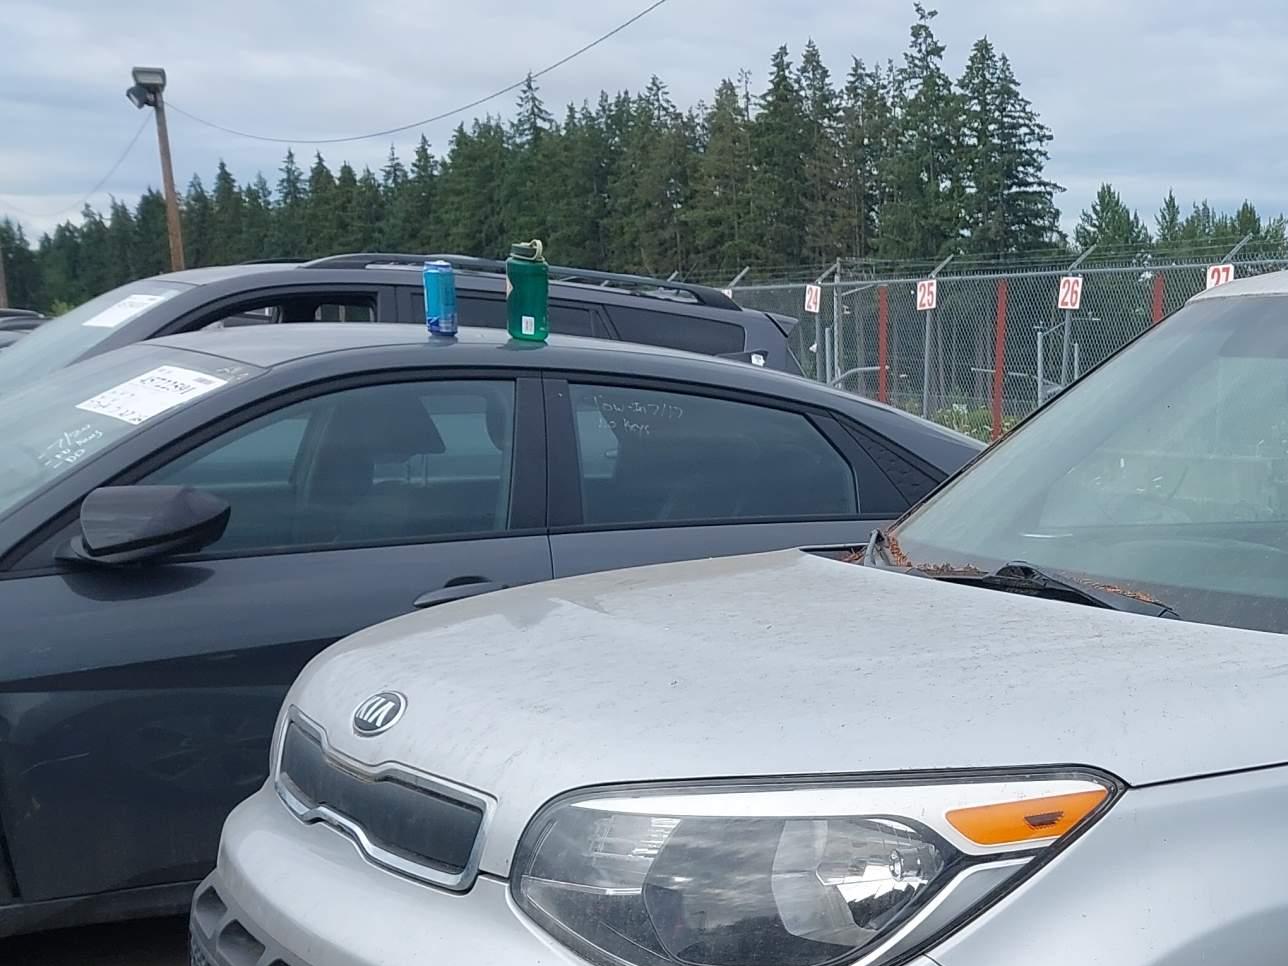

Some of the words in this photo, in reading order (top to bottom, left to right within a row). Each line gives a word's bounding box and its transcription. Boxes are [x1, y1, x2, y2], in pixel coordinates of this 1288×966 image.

[806, 287, 818, 311] 24
[918, 282, 935, 308] 25
[1060, 279, 1079, 307] 26
[355, 696, 396, 728] KIA
